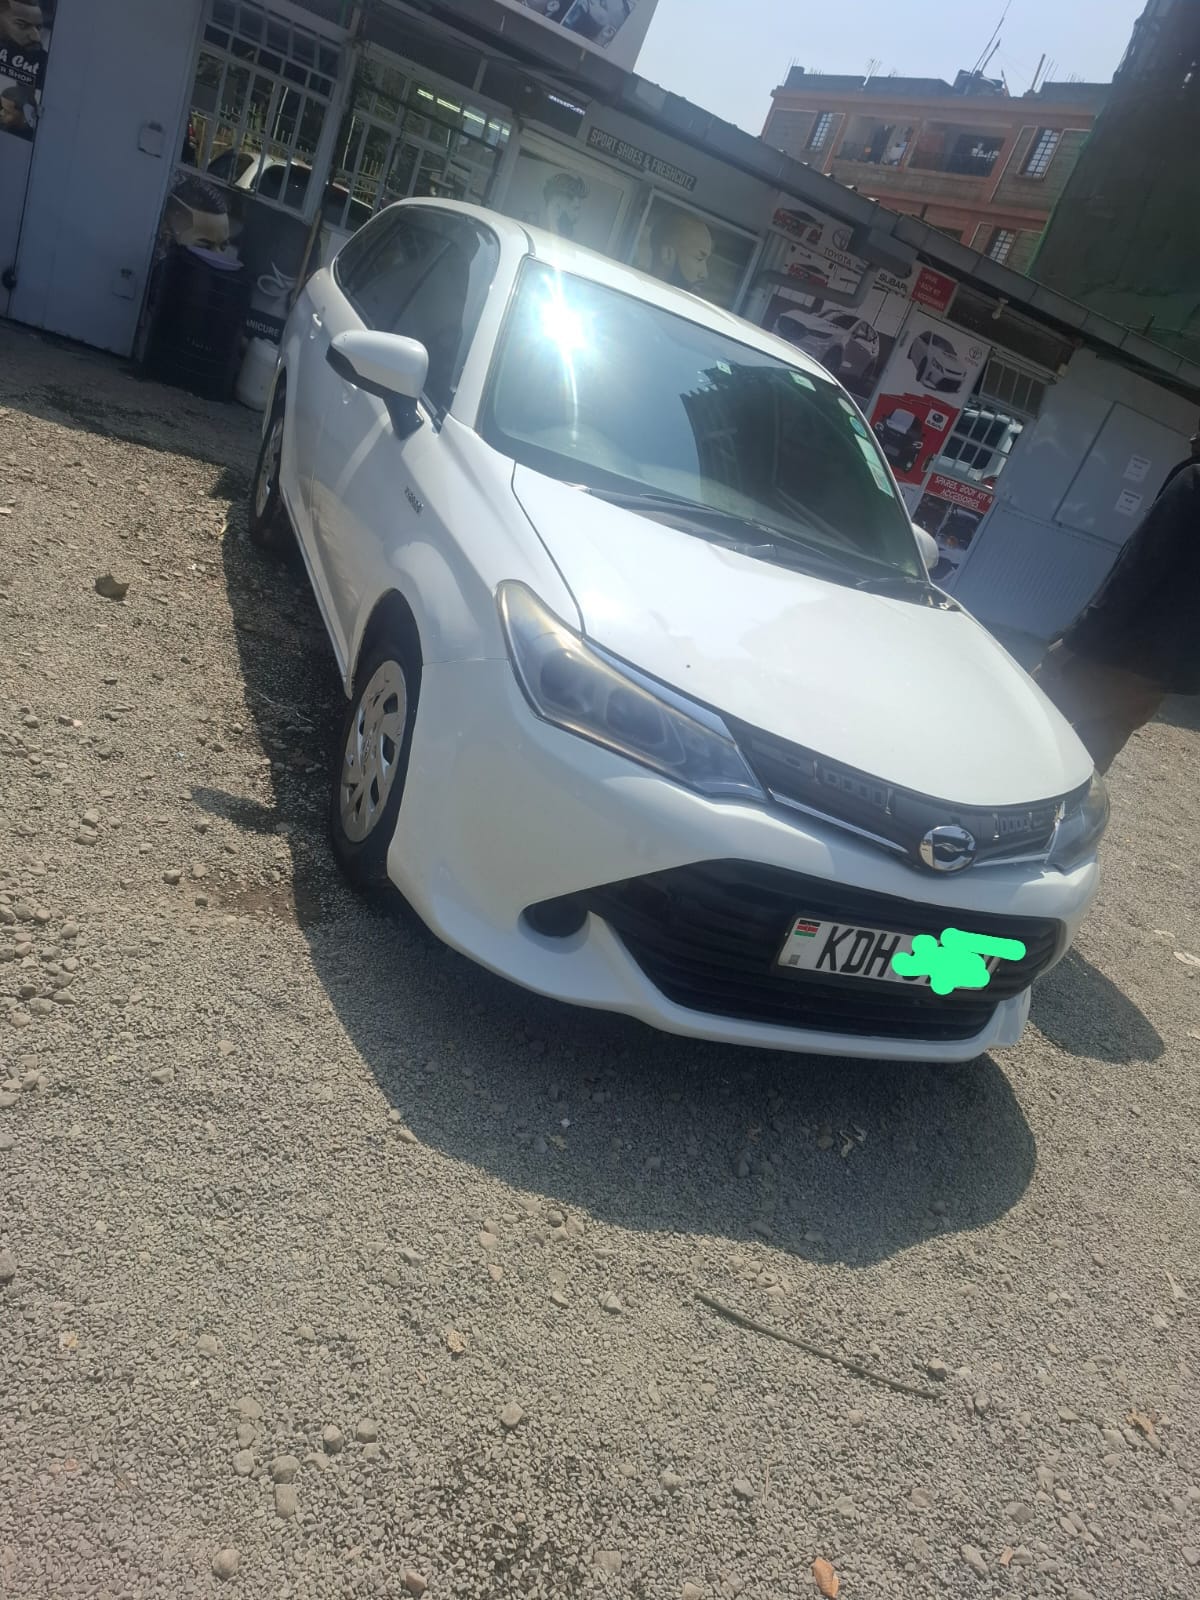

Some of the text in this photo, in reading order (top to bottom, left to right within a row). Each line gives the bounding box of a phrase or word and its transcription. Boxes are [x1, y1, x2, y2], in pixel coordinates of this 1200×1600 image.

[11, 55, 40, 74] Cut
[8, 68, 33, 82] SHOP
[590, 128, 618, 152] SPORT
[616, 140, 645, 166] SHOES
[642, 156, 650, 169] &
[823, 247, 853, 266] TOYOTA
[246, 319, 279, 337] ANICURE
[940, 488, 980, 508] ACCESSORIES
[959, 484, 978, 497] BODY
[815, 925, 901, 977] KDH
